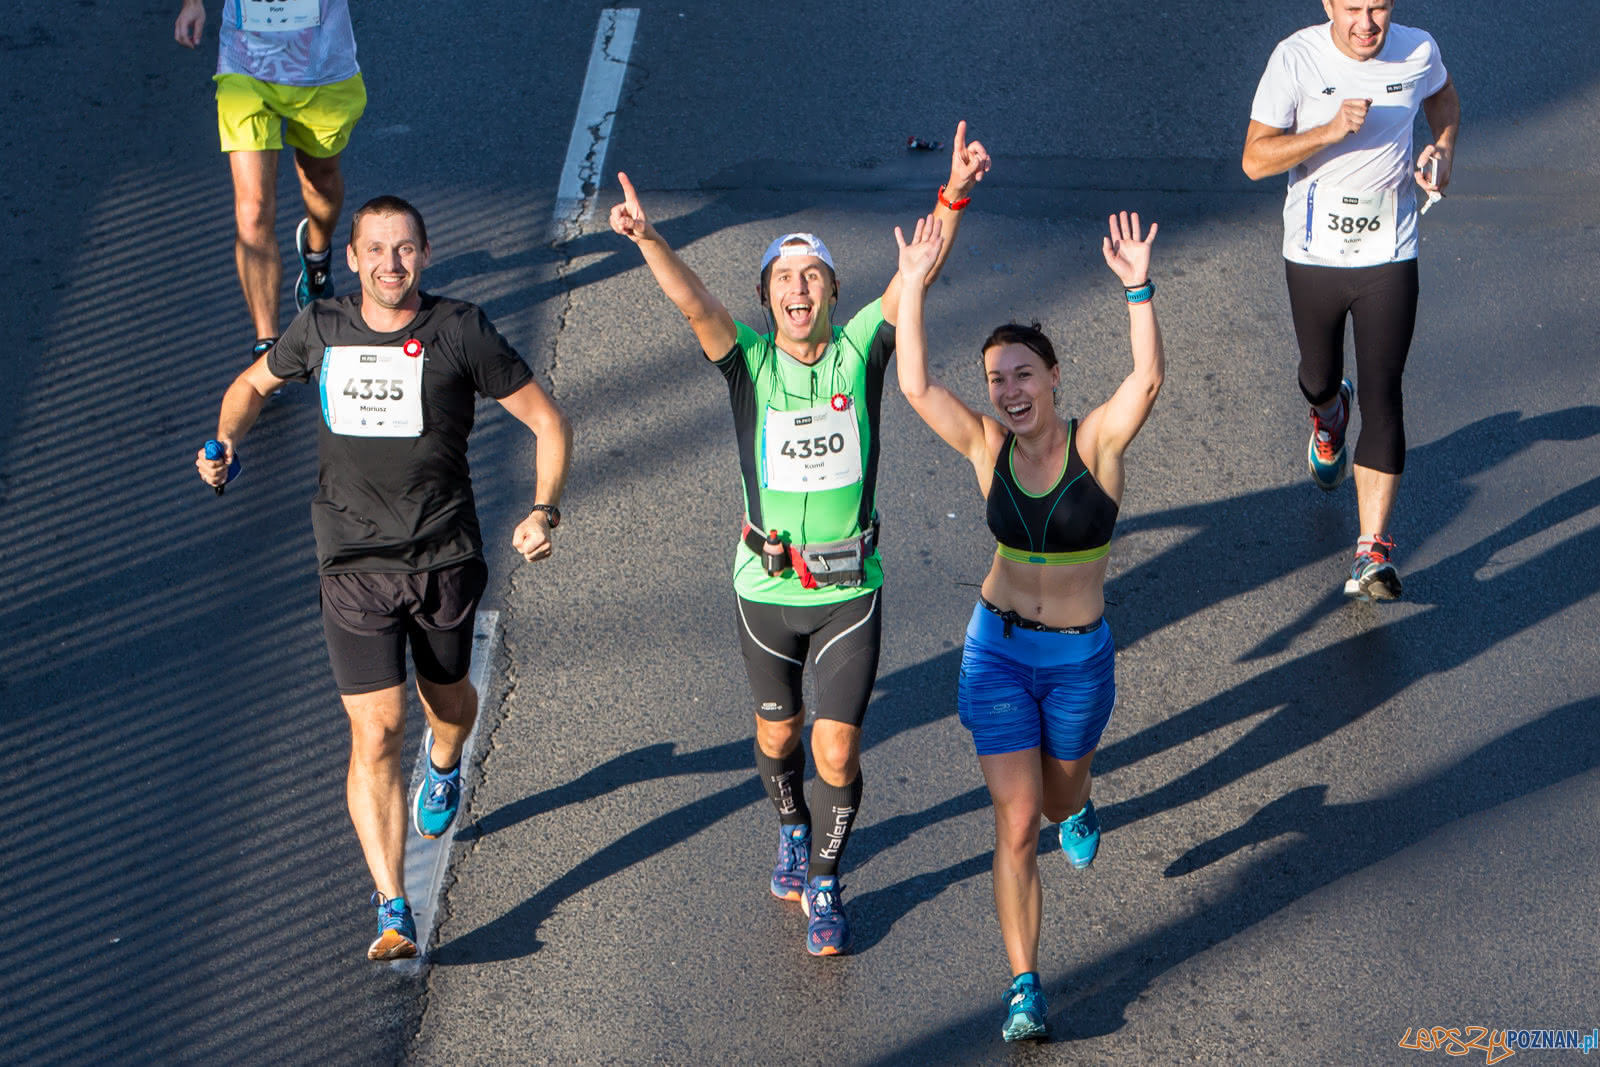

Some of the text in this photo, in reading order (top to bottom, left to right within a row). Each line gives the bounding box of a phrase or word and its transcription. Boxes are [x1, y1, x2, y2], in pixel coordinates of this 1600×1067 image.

[1327, 213, 1381, 234] 3896
[343, 378, 404, 401] 4335
[780, 432, 845, 459] 4350
[804, 462, 825, 470] Kamil
